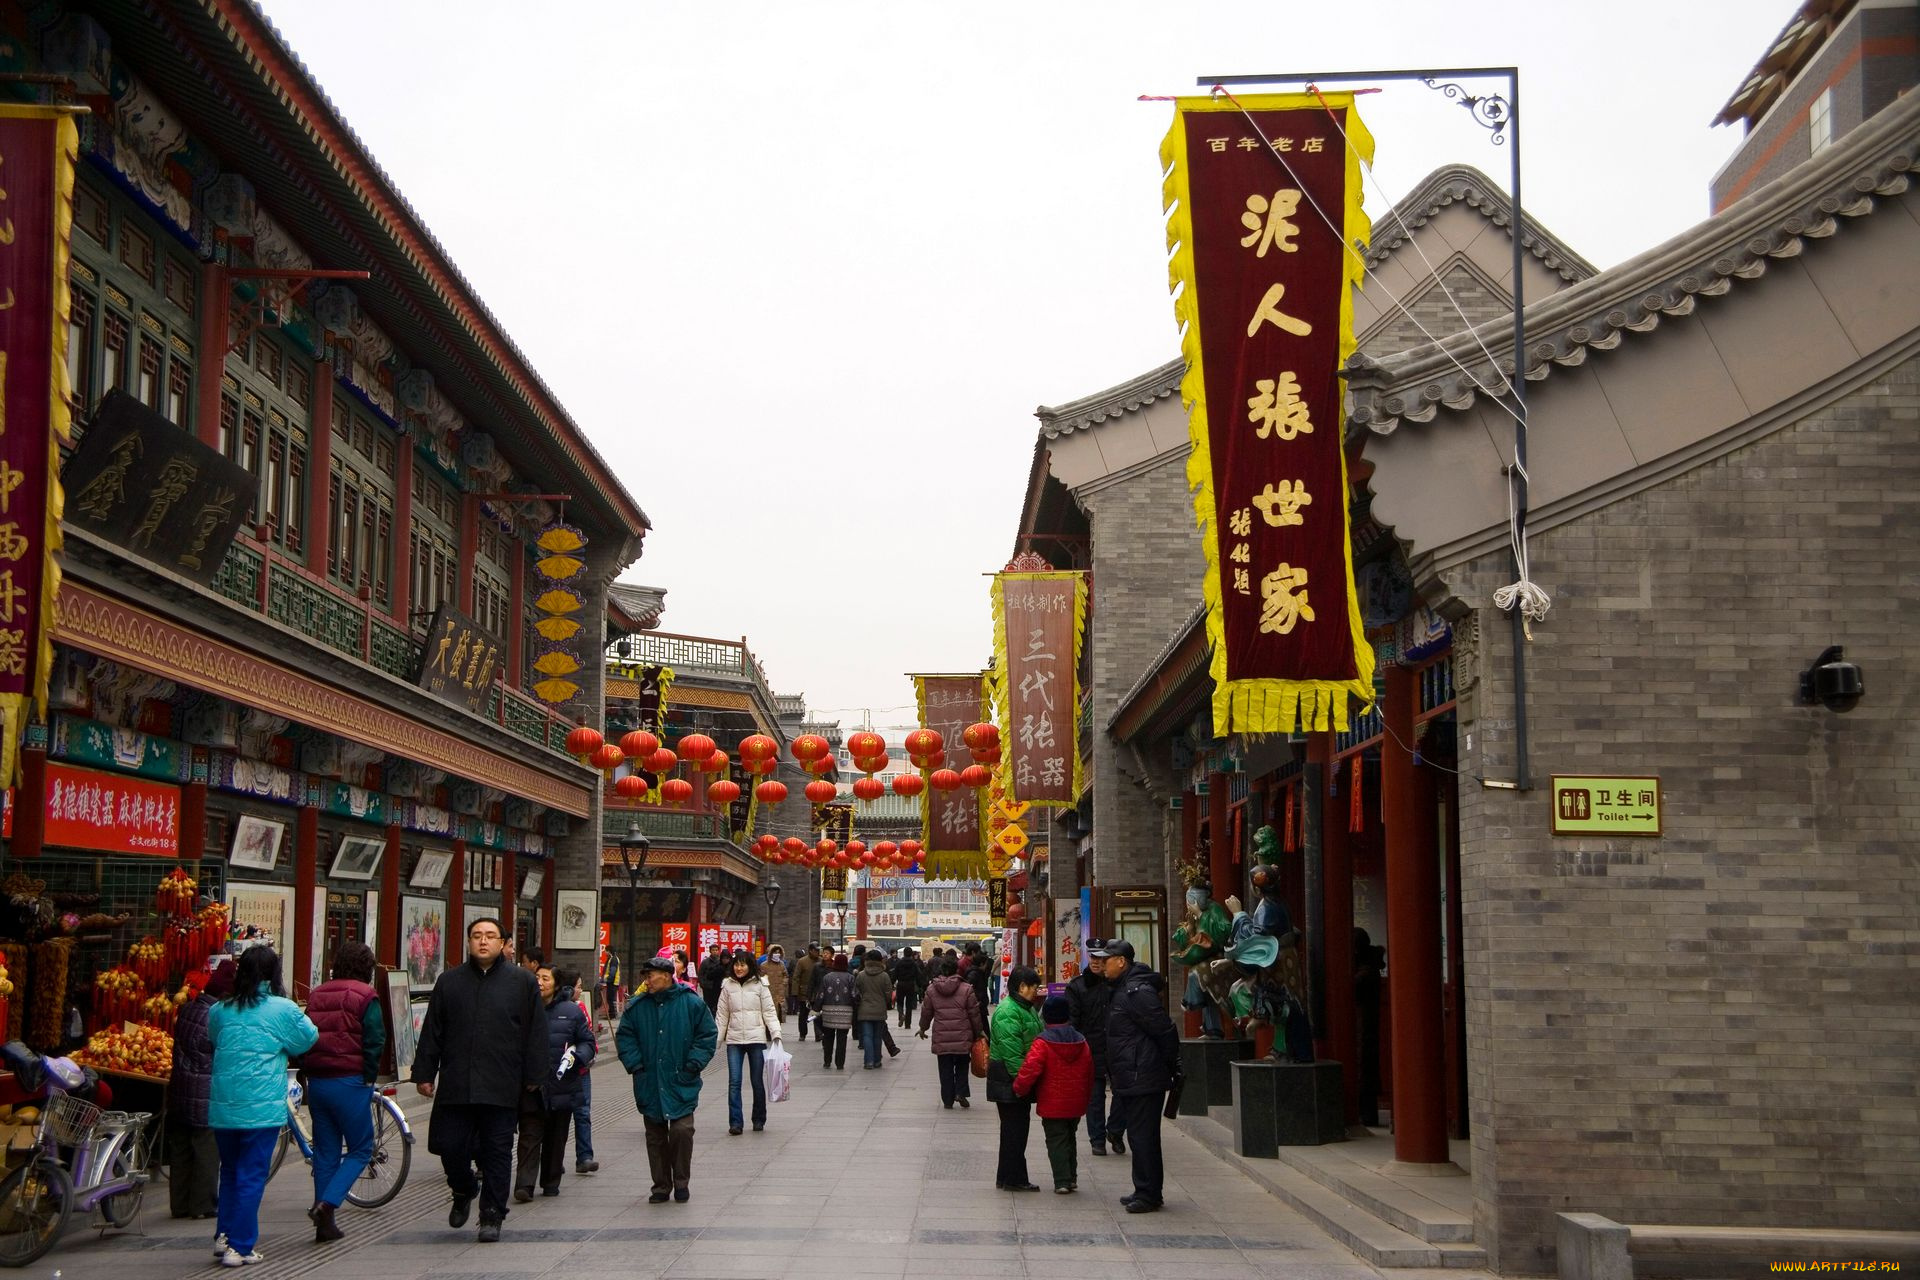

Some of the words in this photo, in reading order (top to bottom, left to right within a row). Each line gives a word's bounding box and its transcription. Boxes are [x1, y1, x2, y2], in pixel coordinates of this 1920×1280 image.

[1206, 136, 1325, 153] 百年老店
[1240, 188, 1316, 635] 泥人張世家
[1007, 593, 1067, 614] 祖传制作
[1016, 754, 1065, 787] 乐器
[1595, 790, 1655, 807] 卫生间
[1597, 813, 1630, 821] Toilet
